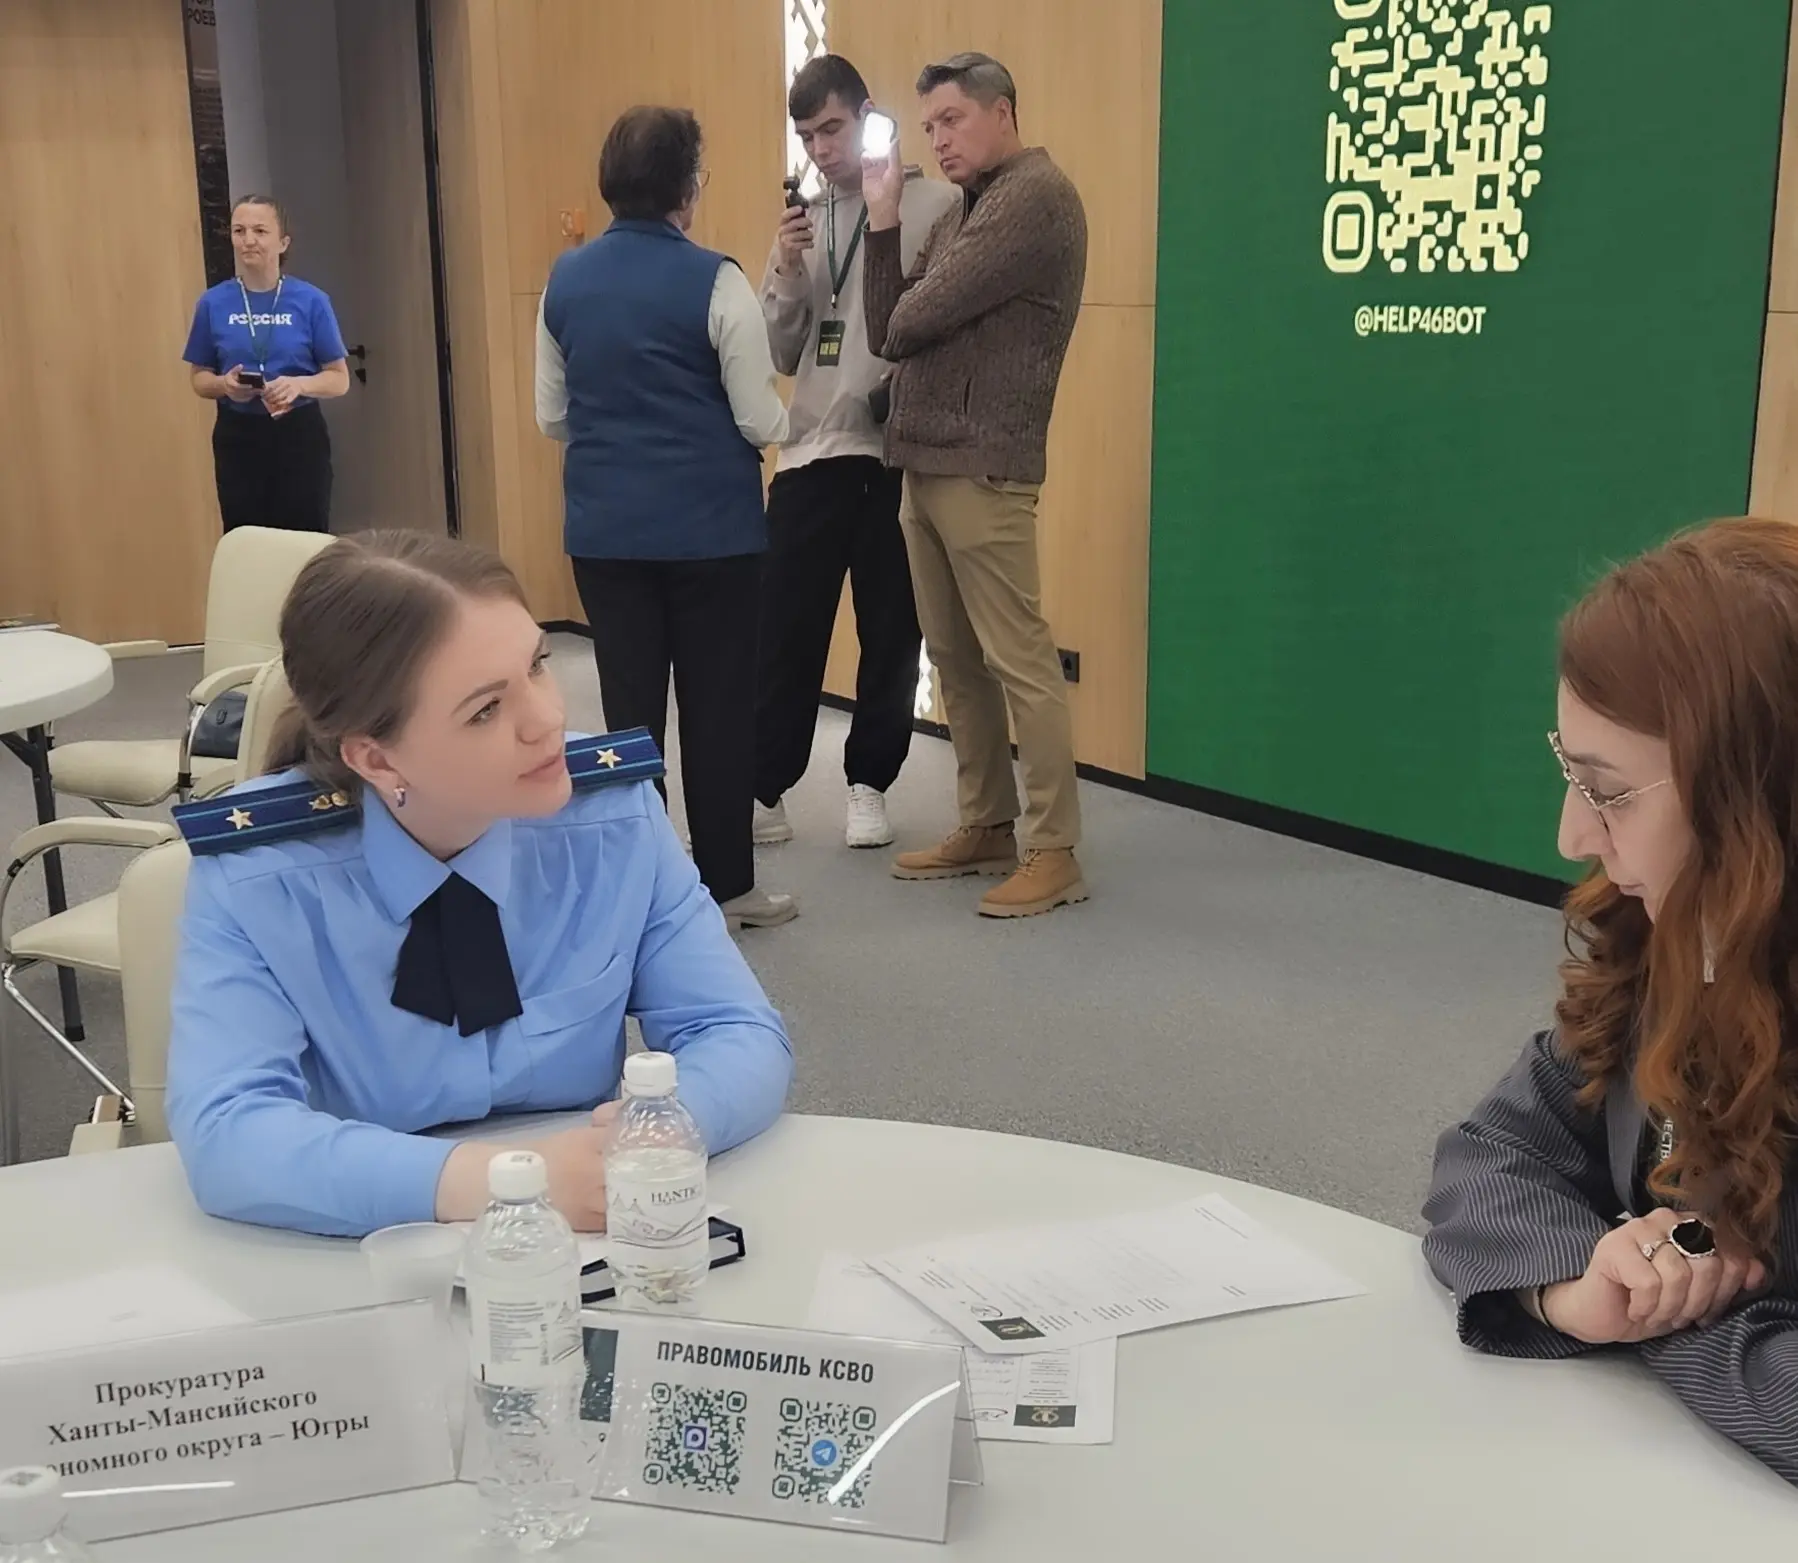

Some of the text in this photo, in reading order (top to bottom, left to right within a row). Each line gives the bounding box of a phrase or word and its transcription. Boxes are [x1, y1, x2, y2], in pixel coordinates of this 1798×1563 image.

[228, 312, 293, 326] РОССИЯ
[1354, 304, 1487, 337] @HELP46BOT
[1660, 1116, 1673, 1163] ЕСТВ
[656, 1340, 874, 1384] ПРАВОМОБИЛЬ КСВО
[95, 1366, 265, 1406] Прокуратура
[48, 1391, 317, 1446] Ханты-Мансийского
[176, 1431, 262, 1459] округа
[291, 1415, 370, 1440] Югры
